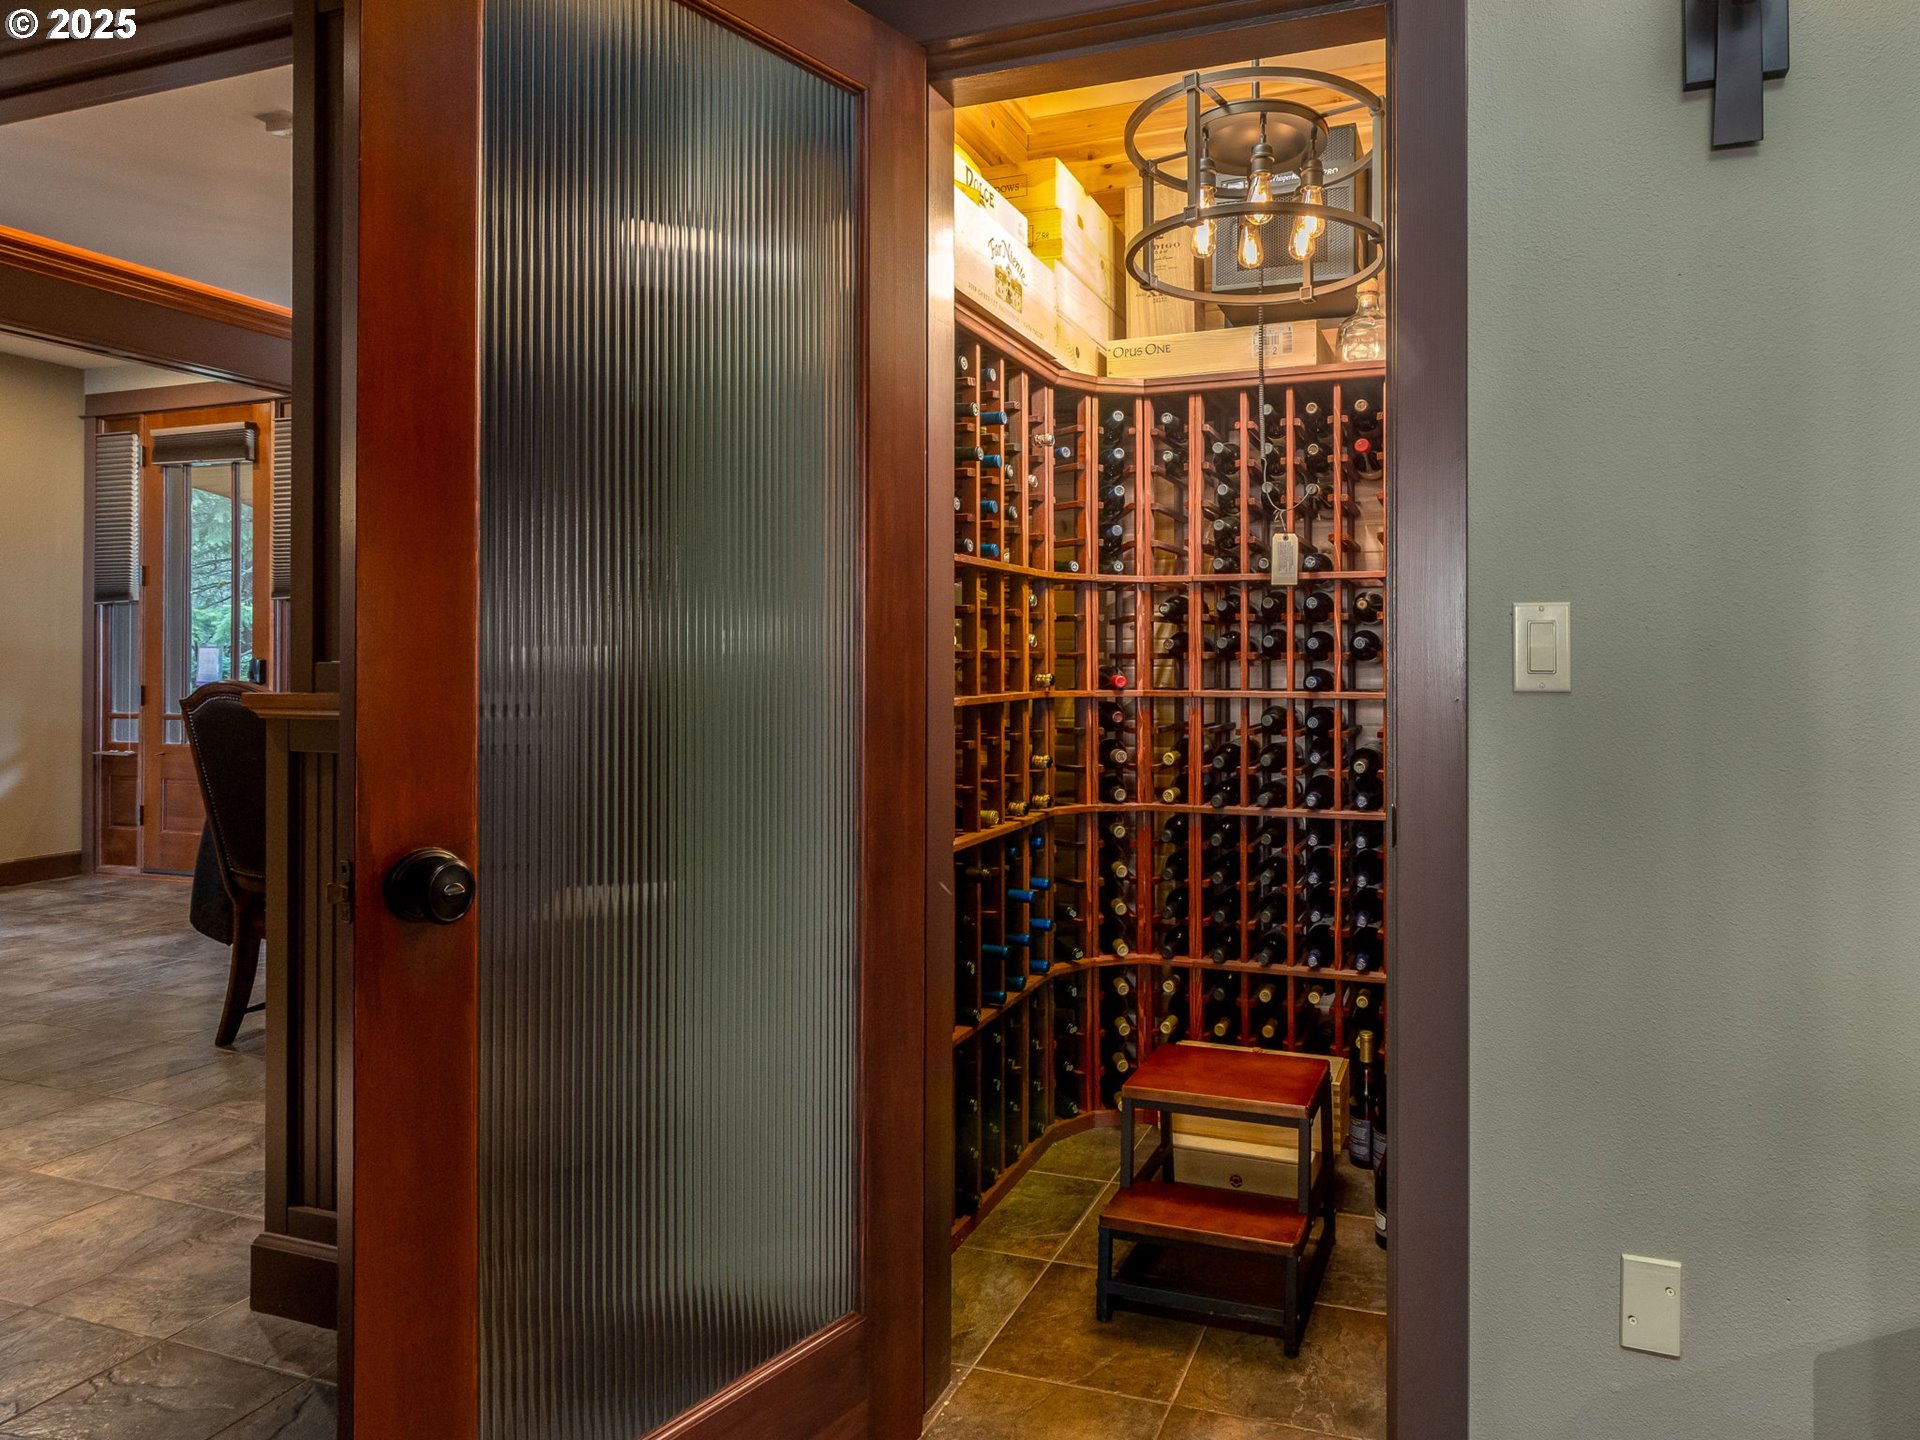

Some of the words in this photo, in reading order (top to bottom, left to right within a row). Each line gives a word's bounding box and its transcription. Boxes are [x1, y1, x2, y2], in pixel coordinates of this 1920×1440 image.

[965, 165, 995, 208] DOLCE
[988, 237, 1002, 260] Far
[1001, 239, 1029, 287] Niente
